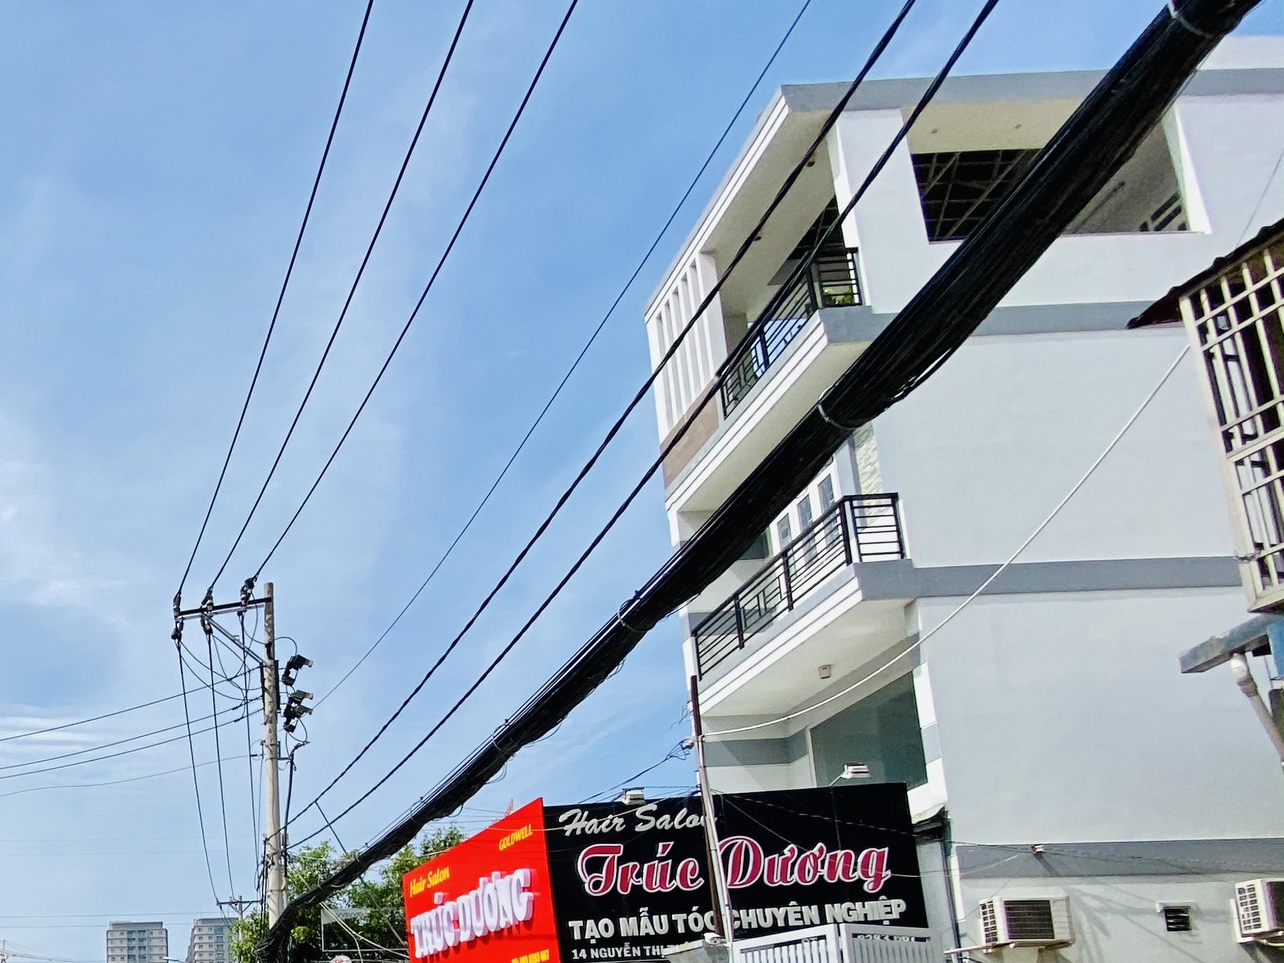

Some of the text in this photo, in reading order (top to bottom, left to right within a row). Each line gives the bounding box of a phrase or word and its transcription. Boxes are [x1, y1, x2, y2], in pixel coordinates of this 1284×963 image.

[499, 824, 533, 851] GOLDWELL
[559, 809, 626, 836] Hair
[578, 836, 892, 896] Trúc Dương
[409, 867, 450, 897] Hair Salon
[410, 868, 534, 959] TRÚC DƯƠNG
[569, 919, 614, 943] TẠO
[621, 907, 669, 937] MẪU
[731, 901, 819, 931] CHUYÊN
[825, 897, 906, 926] NGHIỆP
[572, 949, 587, 959] 14
[591, 942, 641, 958] NGUYỄN
